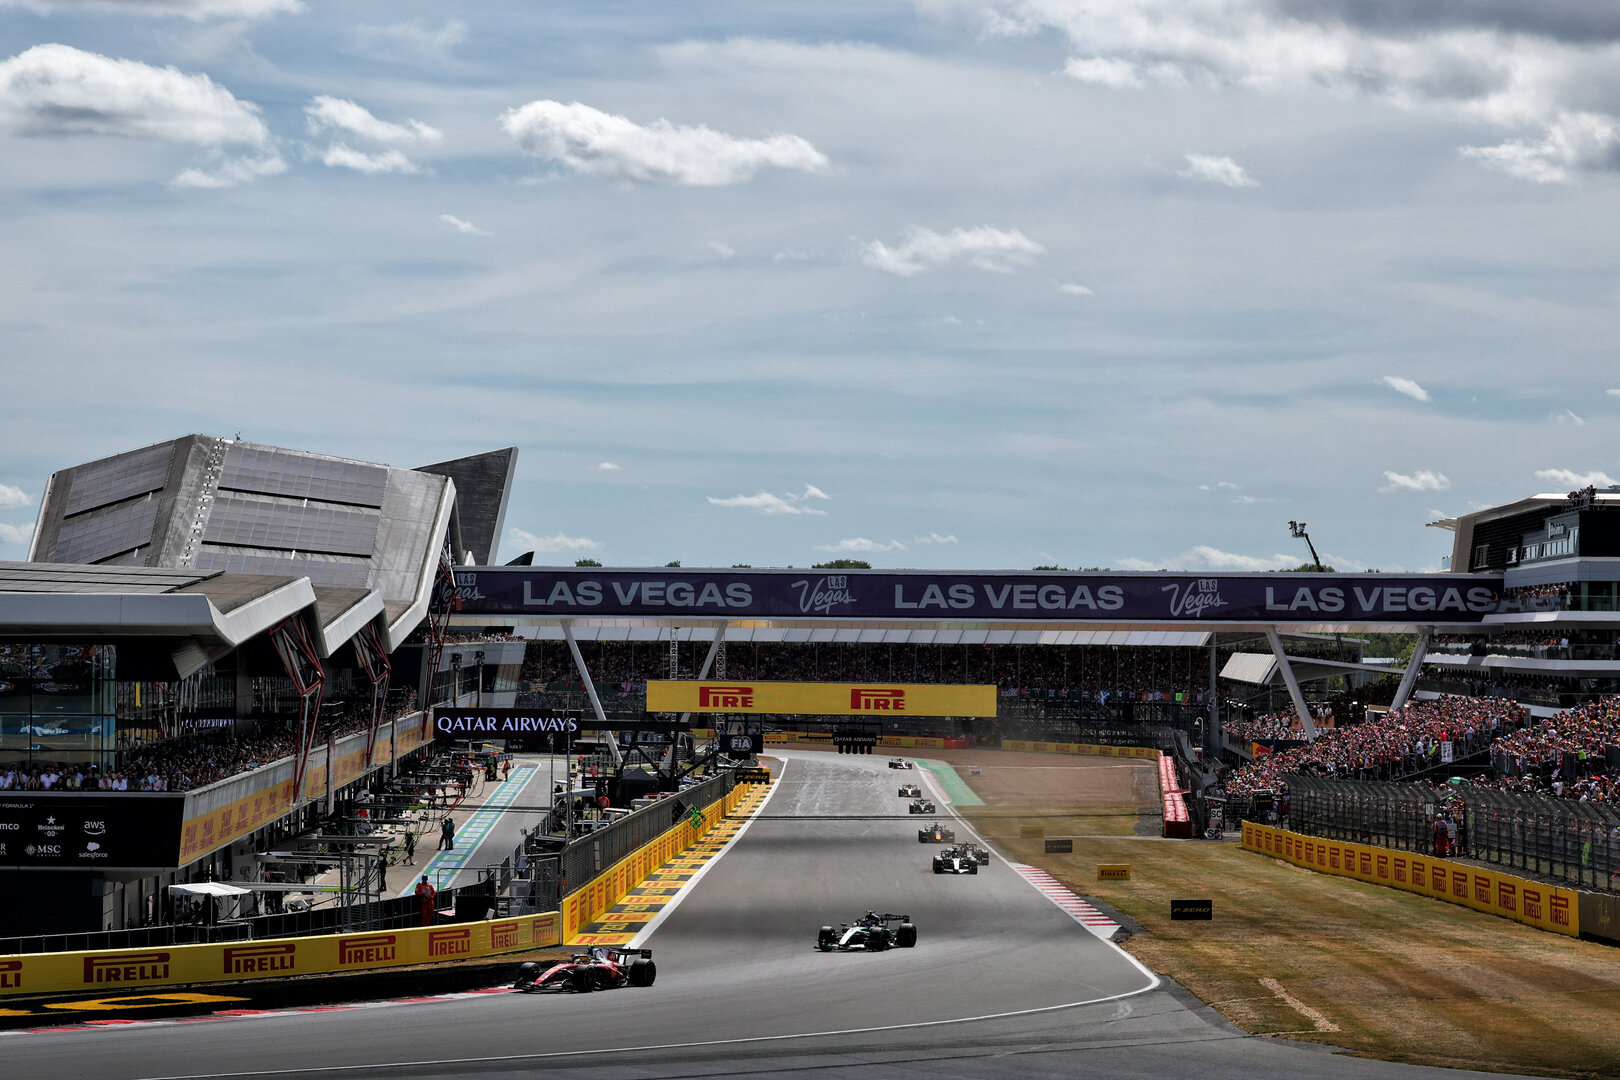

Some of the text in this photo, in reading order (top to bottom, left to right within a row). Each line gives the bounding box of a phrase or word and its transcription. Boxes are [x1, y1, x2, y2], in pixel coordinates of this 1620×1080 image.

[523, 581, 753, 608] LAS VEGAS
[827, 575, 847, 589] LAS
[1199, 580, 1217, 592] LAS
[791, 579, 858, 614] Vegas
[894, 584, 1125, 611] LAS VEGAS
[1161, 582, 1229, 617] Vegas
[1265, 586, 1498, 613] LAS VEGAS
[699, 686, 754, 708] PIRE
[850, 688, 905, 711] PIRE
[437, 716, 577, 733] QATAR AIRWAYS
[731, 737, 751, 751] FIA
[84, 821, 105, 829] aws
[1211, 810, 1222, 818] SC
[37, 844, 61, 854] MSC
[1475, 875, 1491, 904] PIRELLI
[1498, 881, 1516, 912] PIRELLI
[1523, 888, 1542, 920] PIRELLI
[1549, 894, 1569, 926] PIRELLI
[428, 929, 471, 956] PIRELLI
[490, 922, 519, 949] PIRELLI
[223, 943, 296, 974] PIRELLI
[338, 935, 397, 965] PIRELLI
[84, 952, 171, 984] PIRELLI
